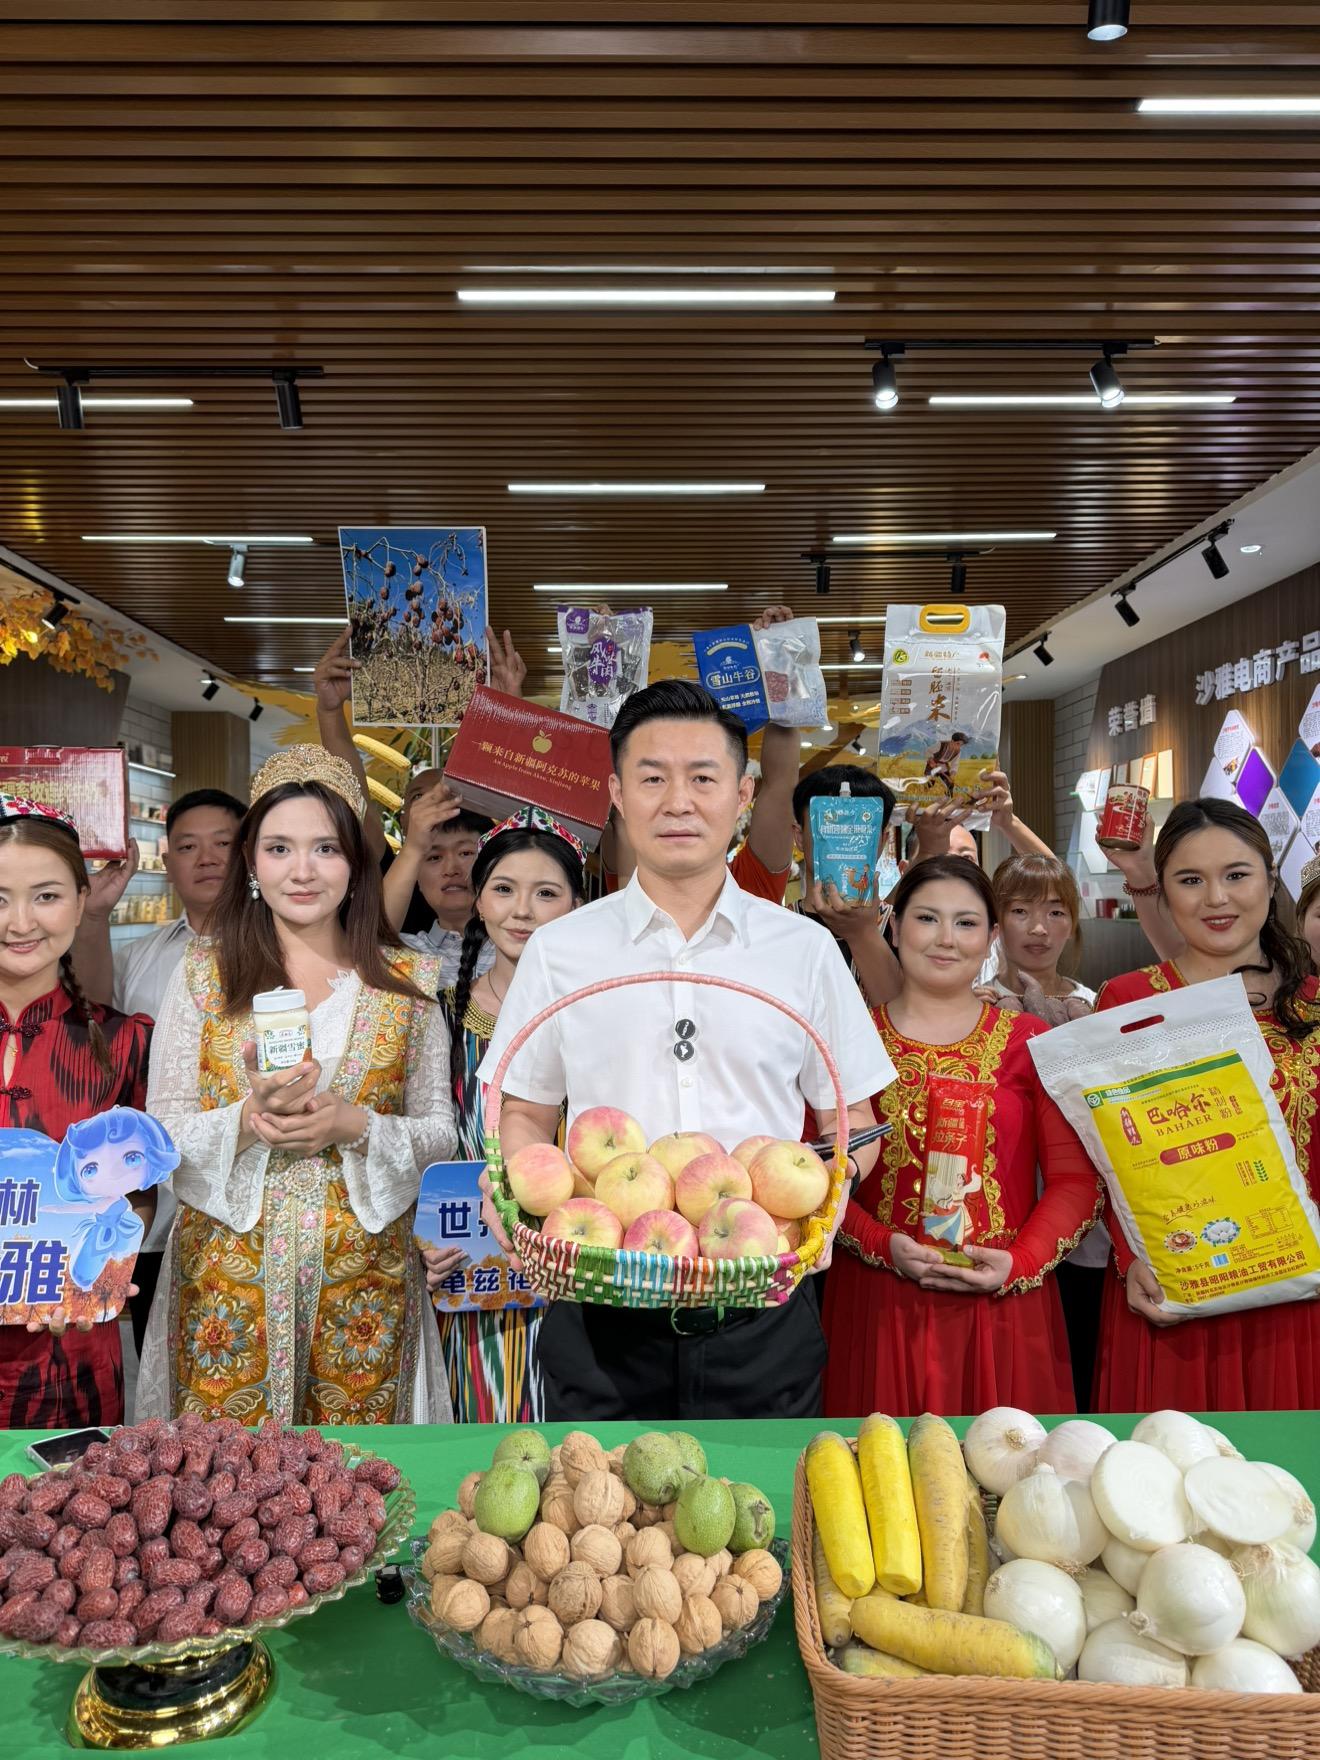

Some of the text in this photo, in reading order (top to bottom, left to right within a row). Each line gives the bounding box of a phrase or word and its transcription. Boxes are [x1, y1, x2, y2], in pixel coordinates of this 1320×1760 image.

[711, 669, 755, 686] 雪山牛谷
[1196, 630, 1320, 705] 沙雅电商产品
[1108, 694, 1156, 736] 荣誉墙
[472, 740, 601, 791] 一颗来自新疆阿克苏的苹果
[270, 1041, 305, 1054] 新疆雪蜜
[1147, 1093, 1211, 1125] 巴哈尔
[1156, 1113, 1213, 1137] BAHAER
[1178, 1137, 1219, 1161] 原味粉
[0, 1240, 67, 1304] 雅
[1180, 1250, 1306, 1291] 沙雅县昭阳粮油工贸有限公司
